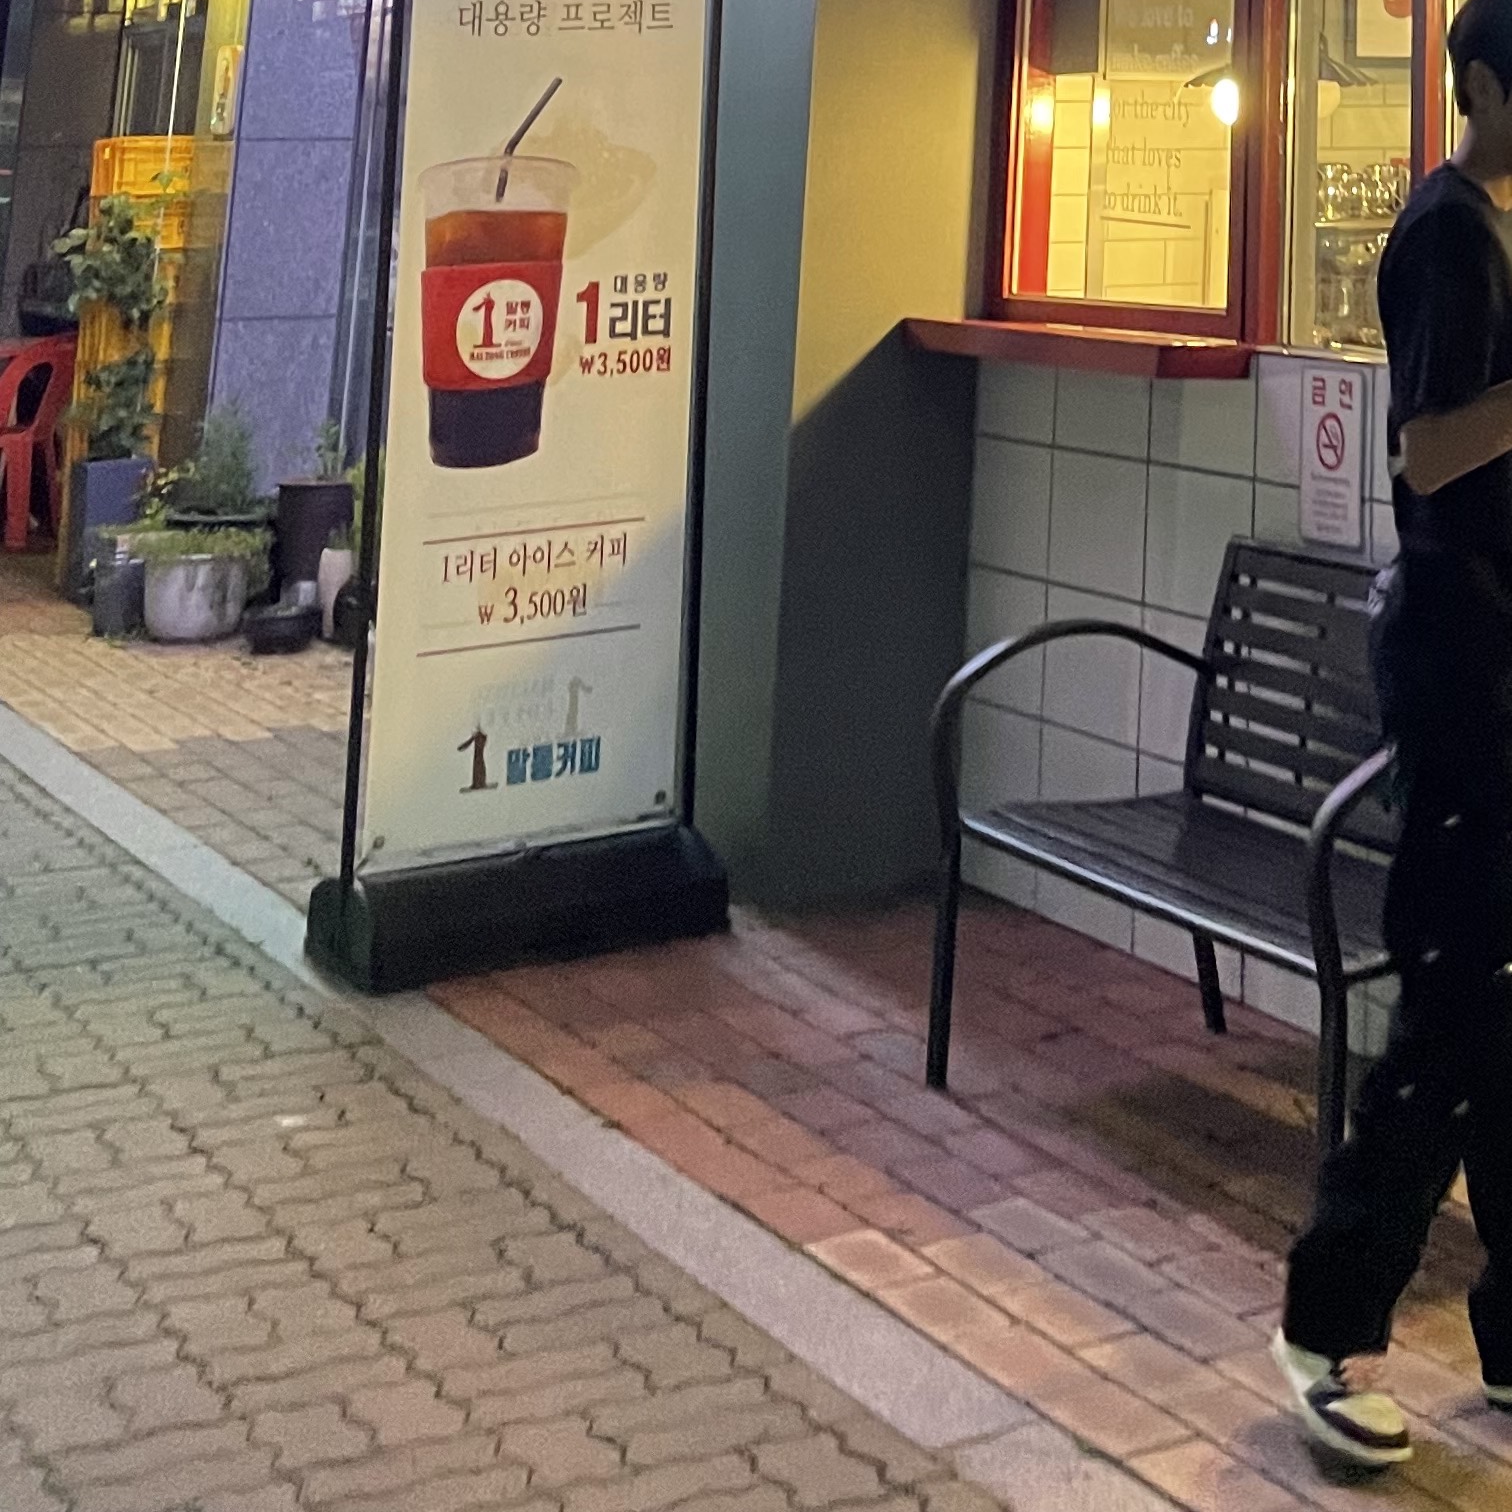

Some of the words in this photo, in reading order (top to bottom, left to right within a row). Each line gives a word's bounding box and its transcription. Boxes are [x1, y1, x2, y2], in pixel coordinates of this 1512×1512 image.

[458, 0, 548, 37] 대용량
[1133, 89, 1160, 120] the
[1162, 99, 1191, 128] city
[1141, 136, 1182, 169] loves
[1120, 181, 1162, 216] drink
[608, 296, 673, 342] 리터
[441, 547, 498, 583] 1리터
[507, 539, 578, 578] 아이스
[584, 530, 629, 569] 커피
